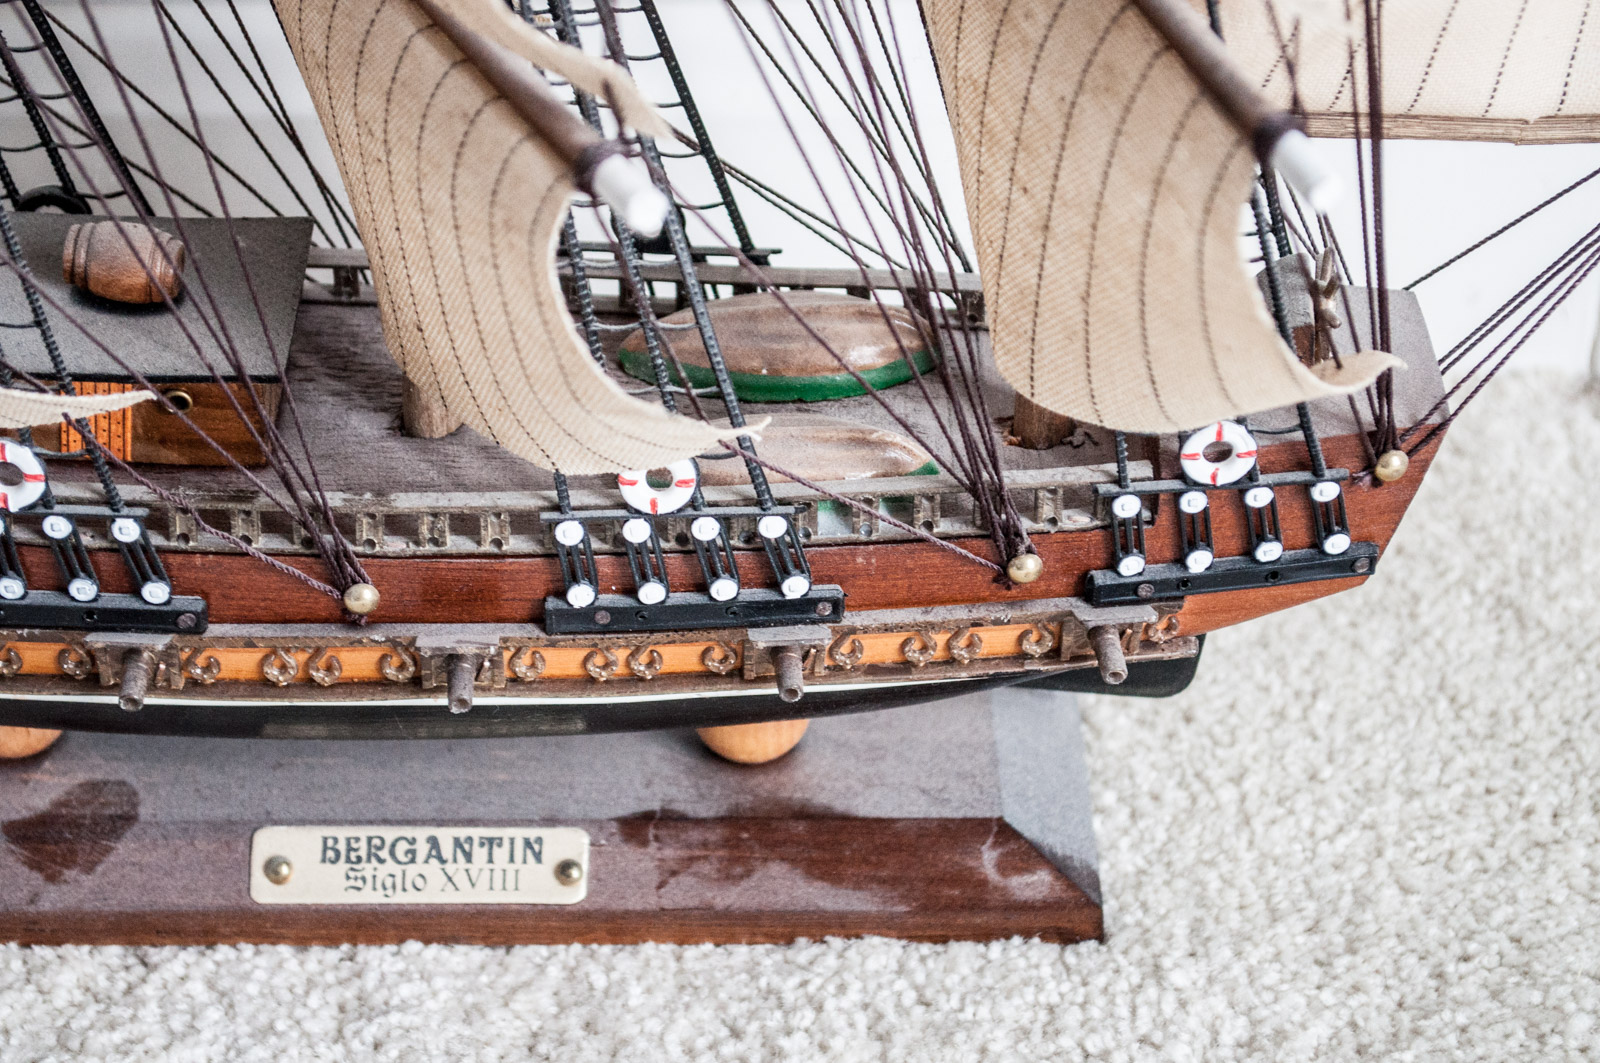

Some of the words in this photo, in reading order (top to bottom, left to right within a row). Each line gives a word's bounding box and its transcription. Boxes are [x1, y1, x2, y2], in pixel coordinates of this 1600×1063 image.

[319, 835, 544, 865] BERGANTIN
[344, 866, 427, 898] Siglo
[439, 867, 521, 892] XVIII
